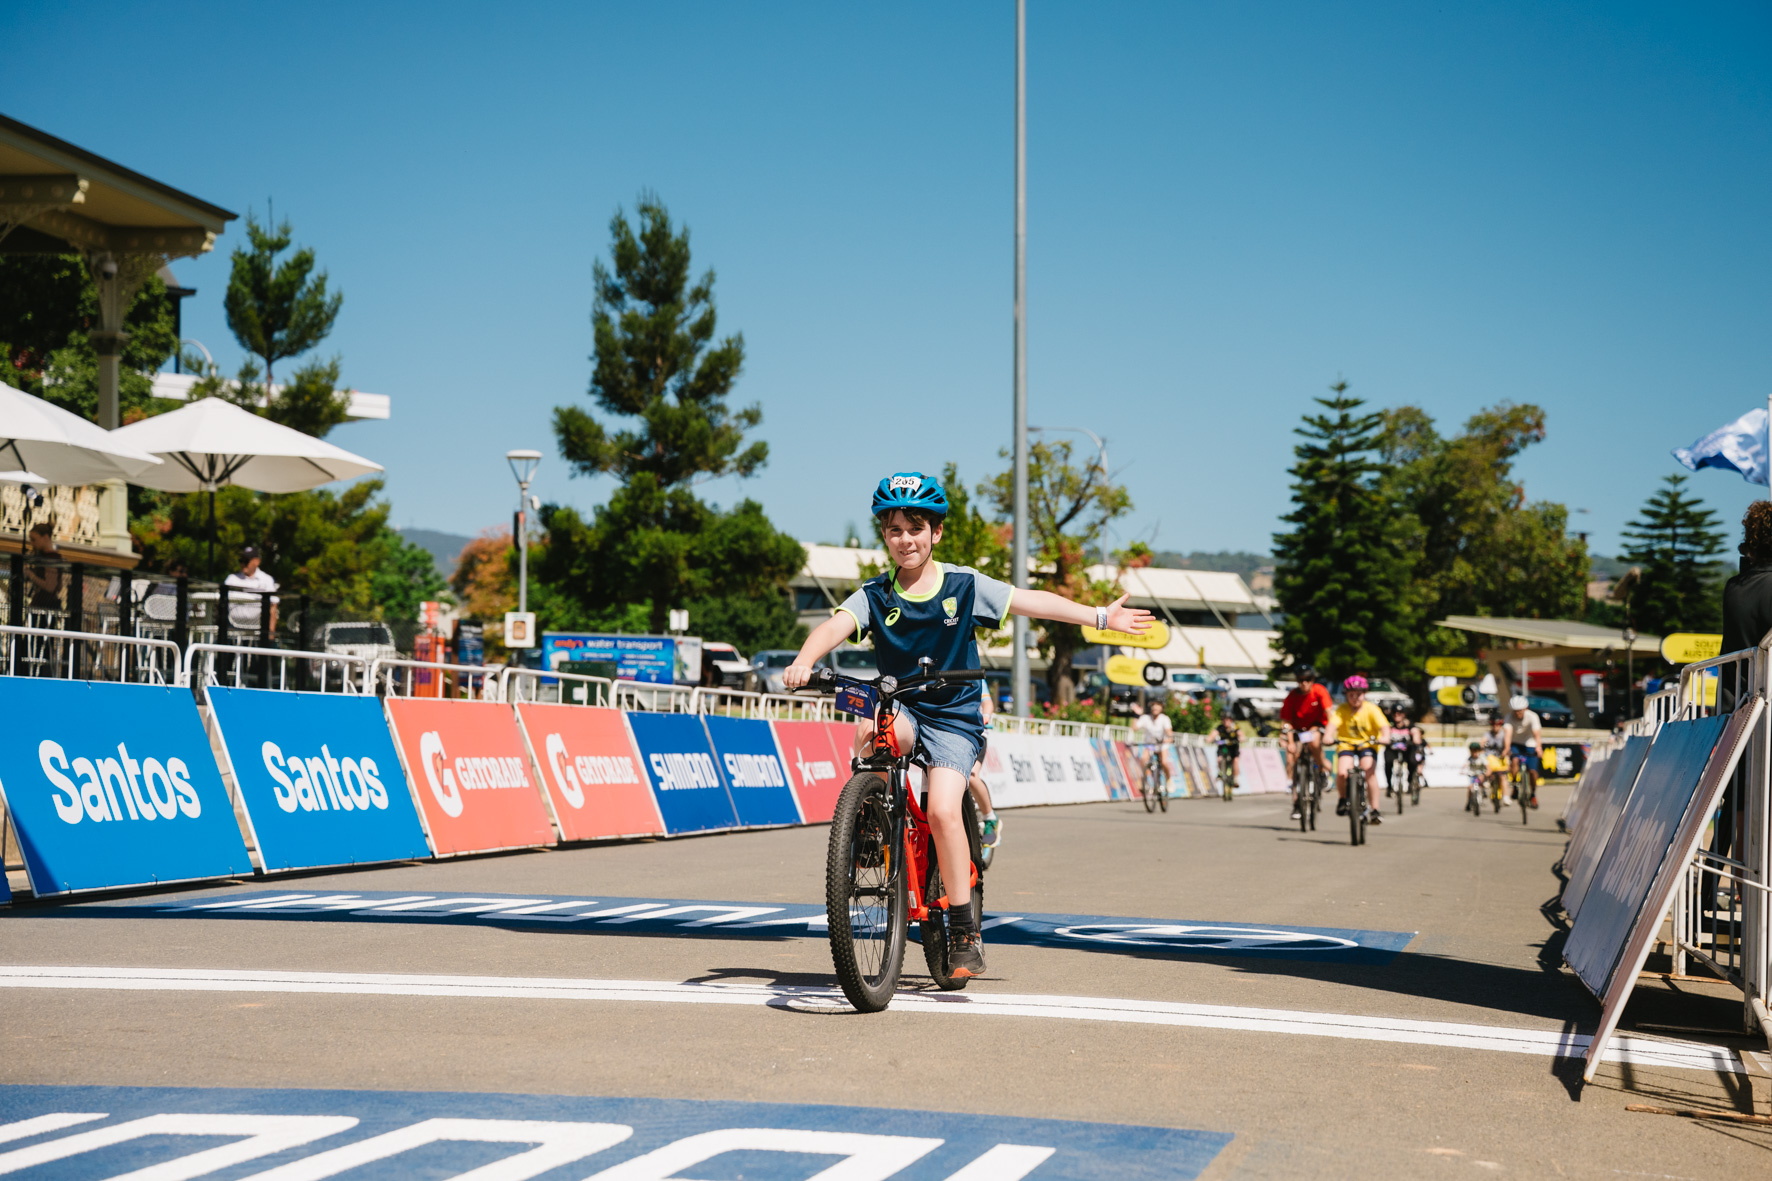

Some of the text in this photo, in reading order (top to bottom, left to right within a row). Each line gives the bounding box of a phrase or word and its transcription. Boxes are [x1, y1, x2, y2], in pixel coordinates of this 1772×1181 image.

[554, 639, 663, 651] andy's water transport
[1694, 640, 1720, 649] SOUT
[847, 695, 865, 708] 75
[38, 739, 202, 824] Santos
[261, 740, 389, 814] Santos
[455, 757, 530, 790] GATORADE
[575, 756, 640, 785] GATORADE
[649, 753, 720, 790] SHIMANO
[723, 753, 785, 788] SHIMANO
[1600, 795, 1665, 907] Santos
